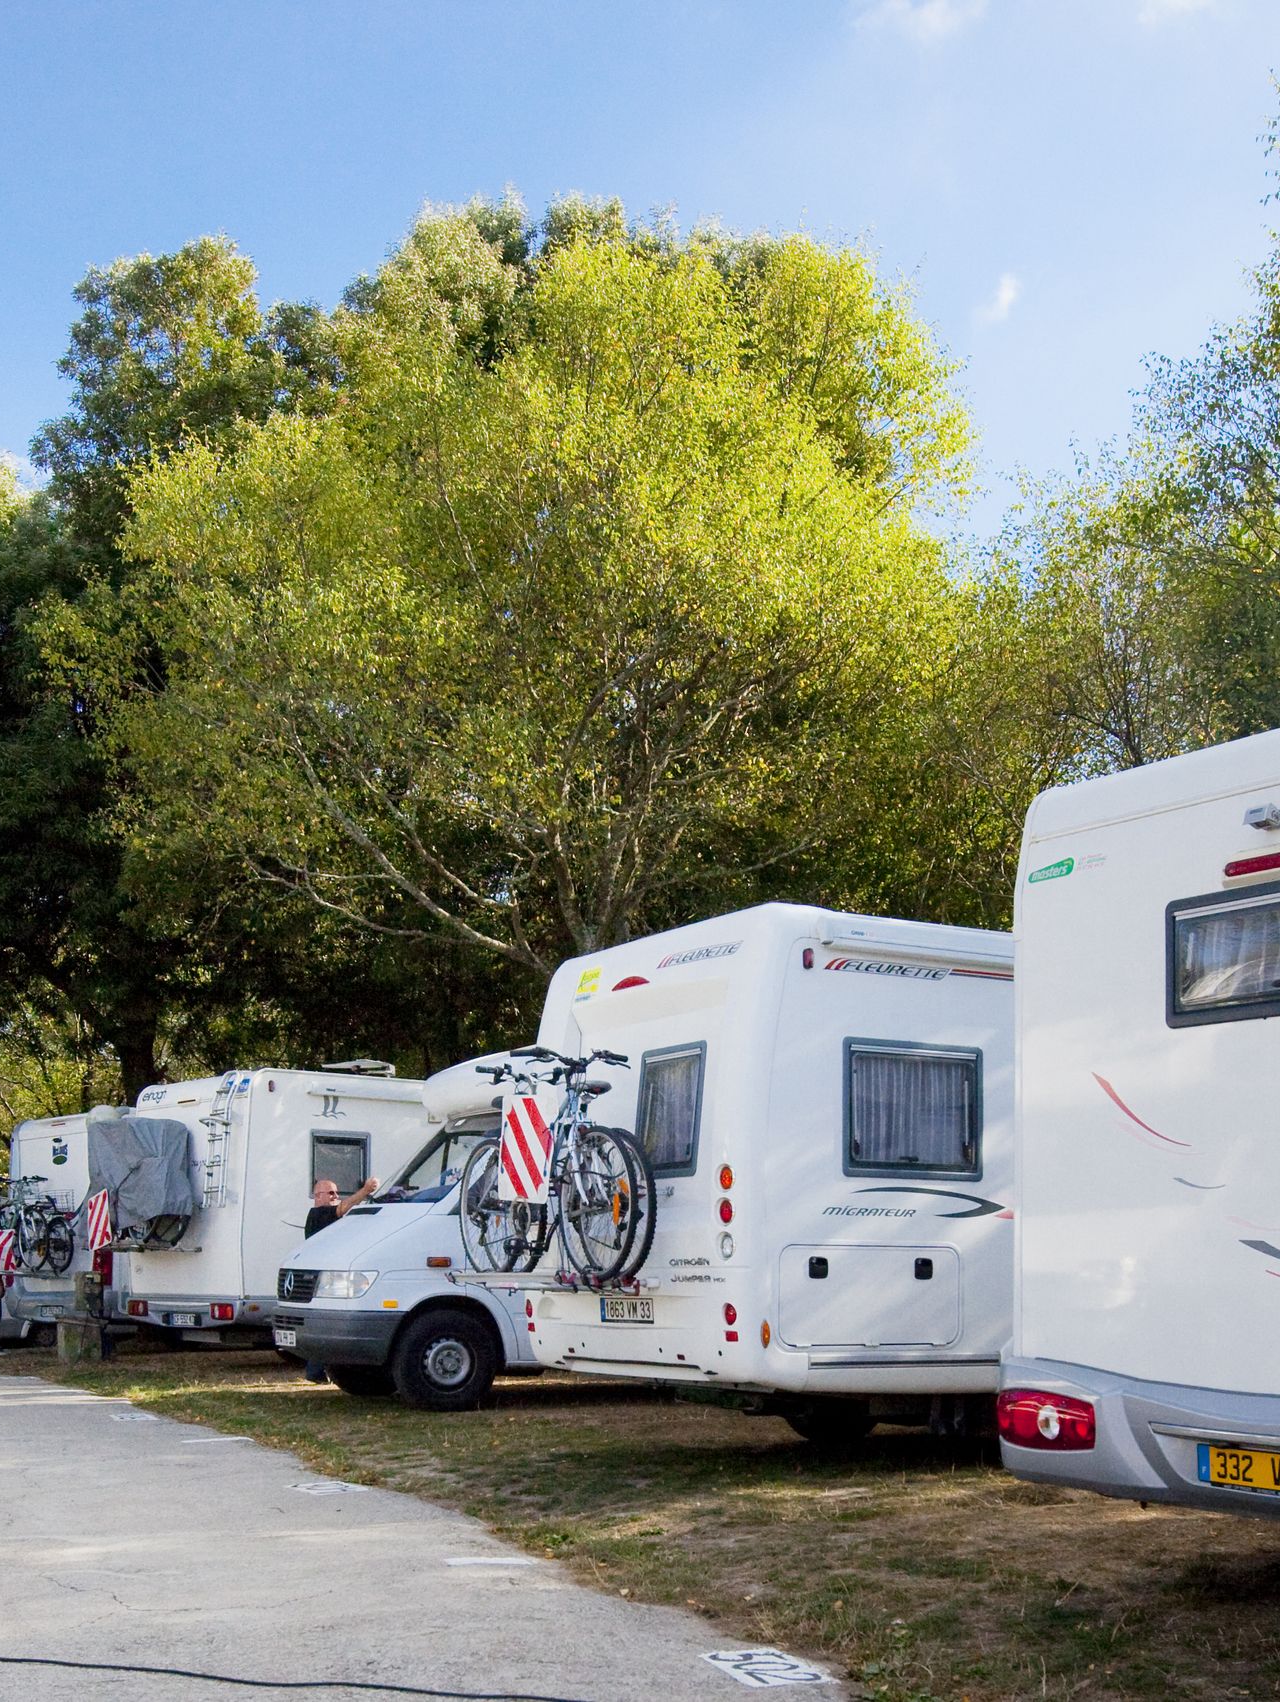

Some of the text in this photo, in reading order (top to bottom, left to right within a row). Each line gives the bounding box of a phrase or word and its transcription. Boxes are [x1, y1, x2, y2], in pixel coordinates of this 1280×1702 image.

[1032, 864, 1068, 881] masters
[668, 942, 742, 967] FLEURETTE
[842, 960, 947, 979] FLEURETTE
[670, 1274, 711, 1283] JUMPER
[626, 1302, 638, 1319] VM
[640, 1303, 651, 1319] 33
[1216, 1451, 1254, 1483] 332
